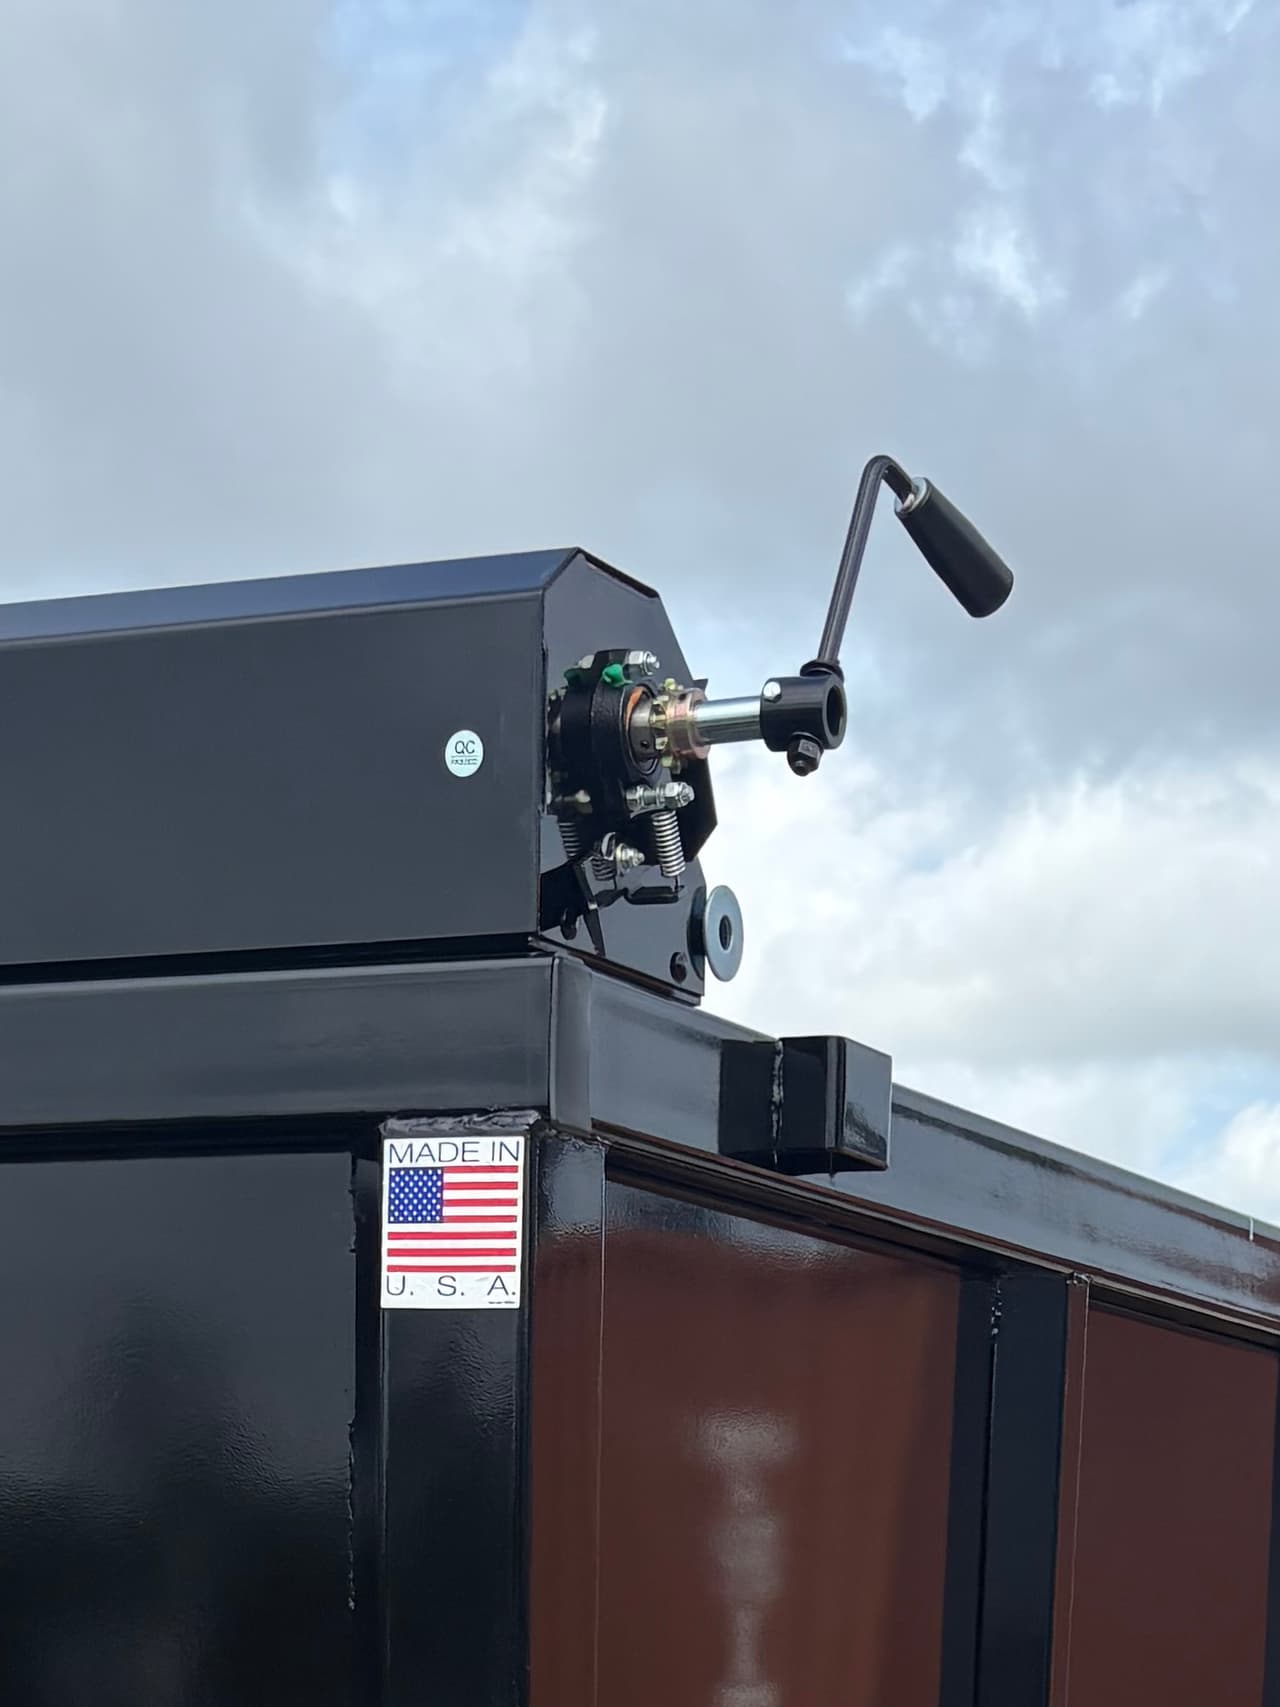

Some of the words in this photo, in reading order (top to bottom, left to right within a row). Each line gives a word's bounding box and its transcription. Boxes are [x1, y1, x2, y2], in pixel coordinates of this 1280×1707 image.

[454, 740, 476, 754] QC
[389, 1141, 481, 1164] MADE
[491, 1140, 521, 1162] IN
[386, 1274, 414, 1296] U.
[437, 1274, 465, 1296] S.
[487, 1274, 517, 1296] A.
